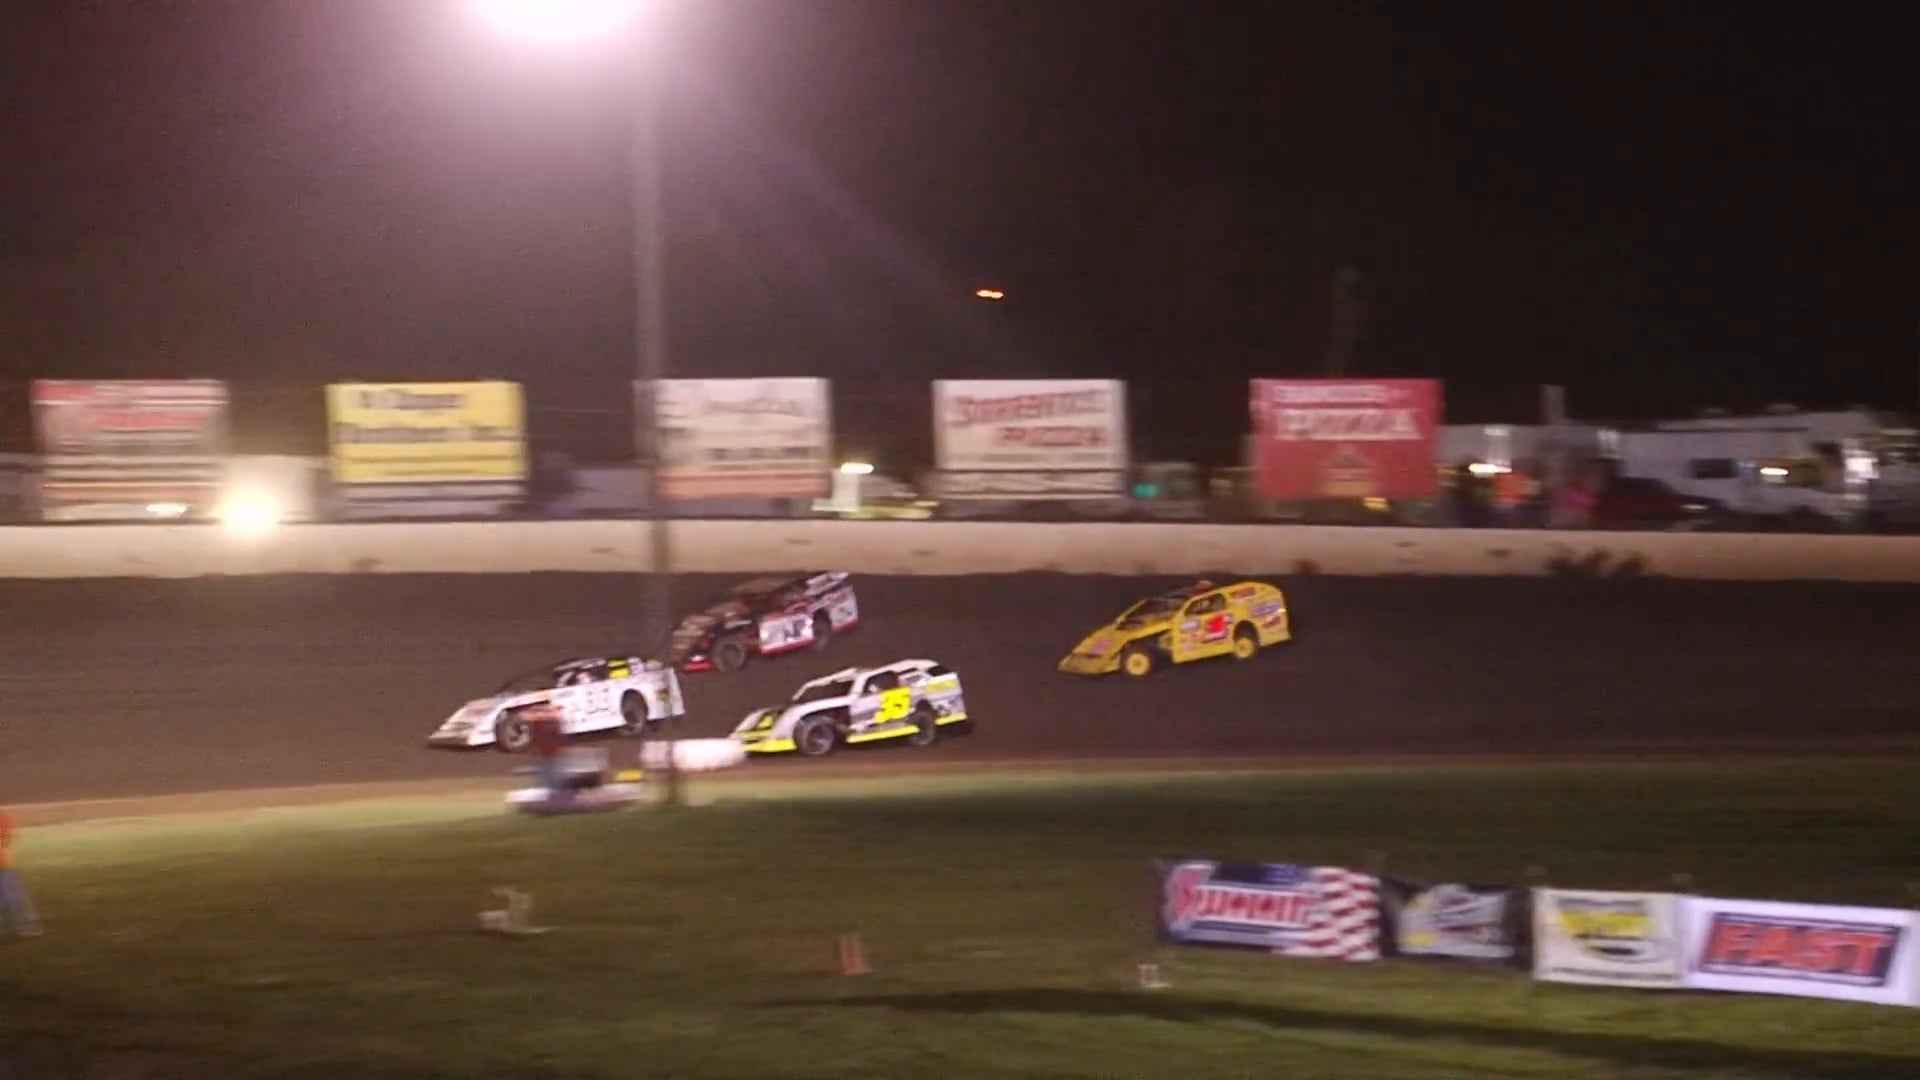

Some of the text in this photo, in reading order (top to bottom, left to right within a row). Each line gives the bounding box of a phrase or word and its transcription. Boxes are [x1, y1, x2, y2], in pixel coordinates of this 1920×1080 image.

[872, 685, 912, 723] 35
[1168, 864, 1316, 926] SUMMIT
[1703, 919, 1892, 976] FAST
